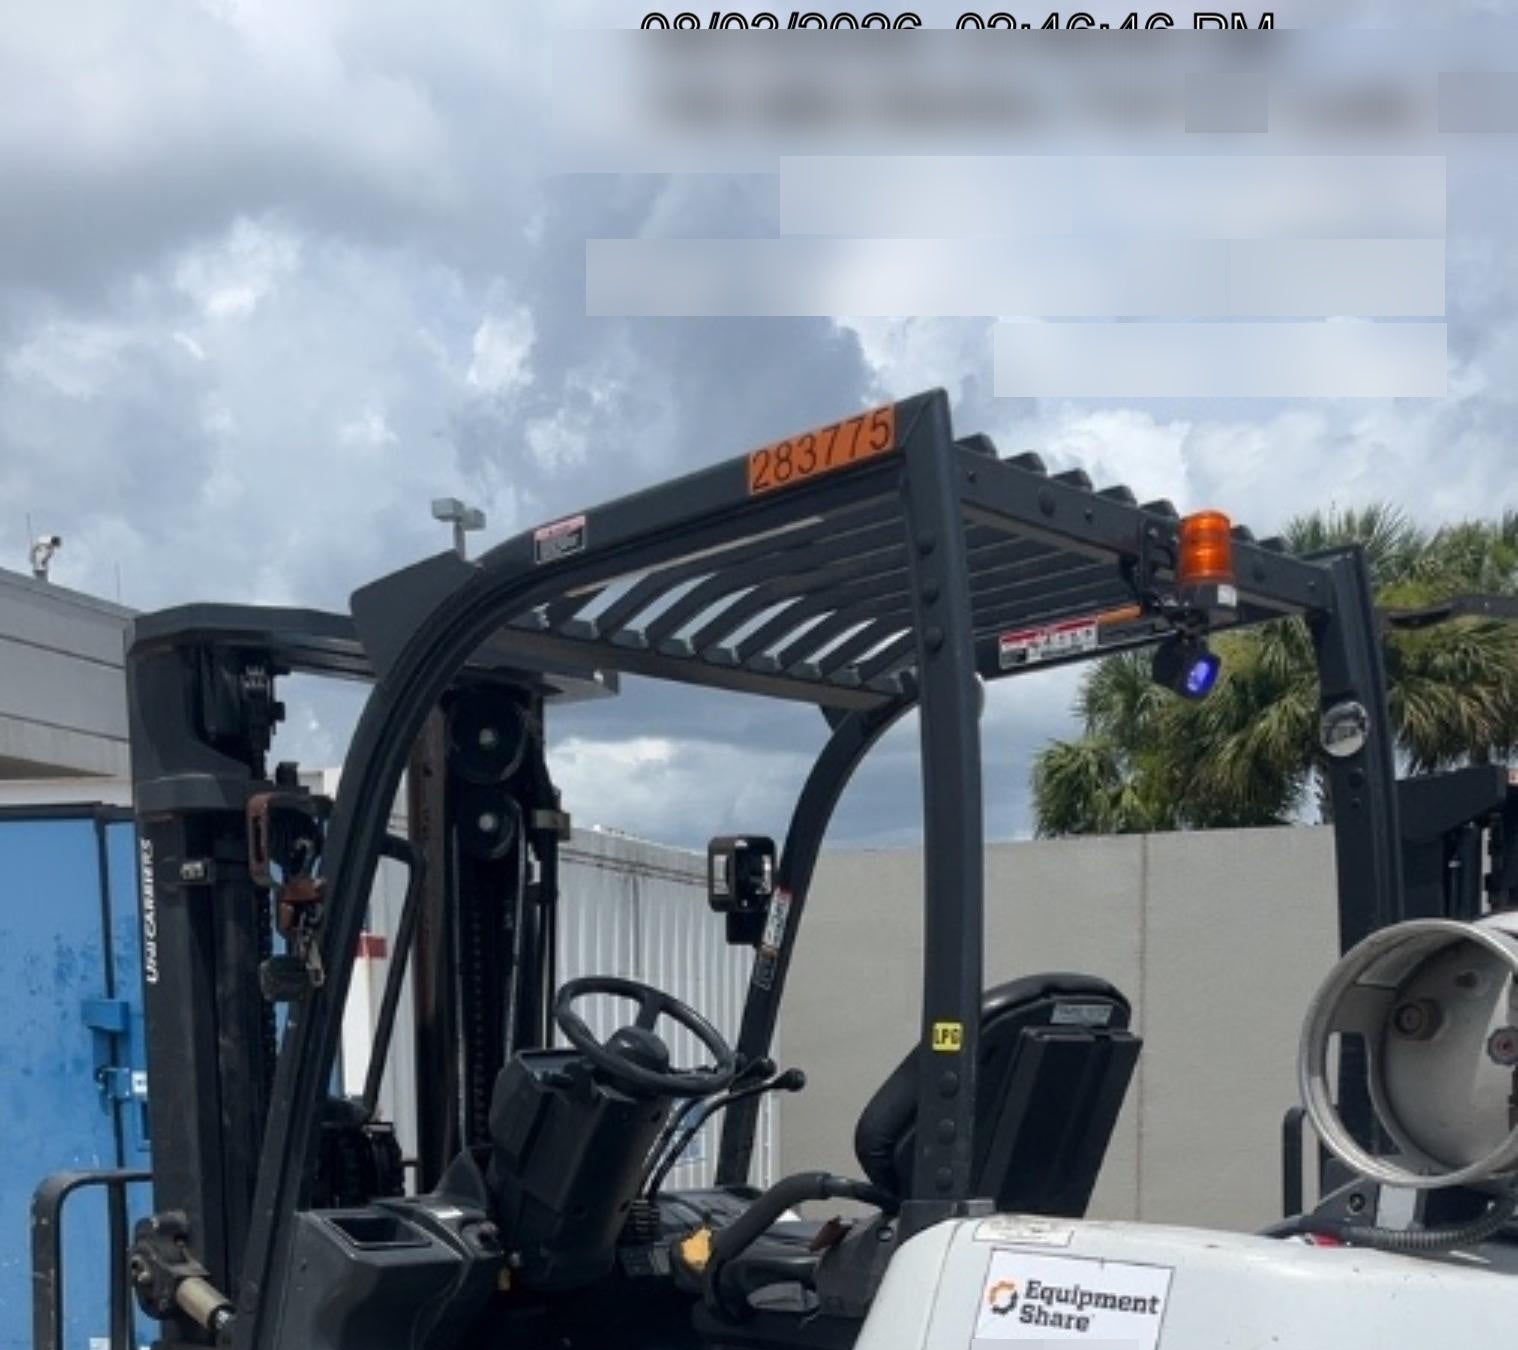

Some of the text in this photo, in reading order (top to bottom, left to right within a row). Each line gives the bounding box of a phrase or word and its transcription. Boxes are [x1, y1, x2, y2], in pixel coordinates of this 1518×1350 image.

[752, 407, 890, 492] 283775
[933, 1027, 962, 1045] LPG
[1024, 1279, 1161, 1316] Equipment
[1018, 1303, 1091, 1333] Share
